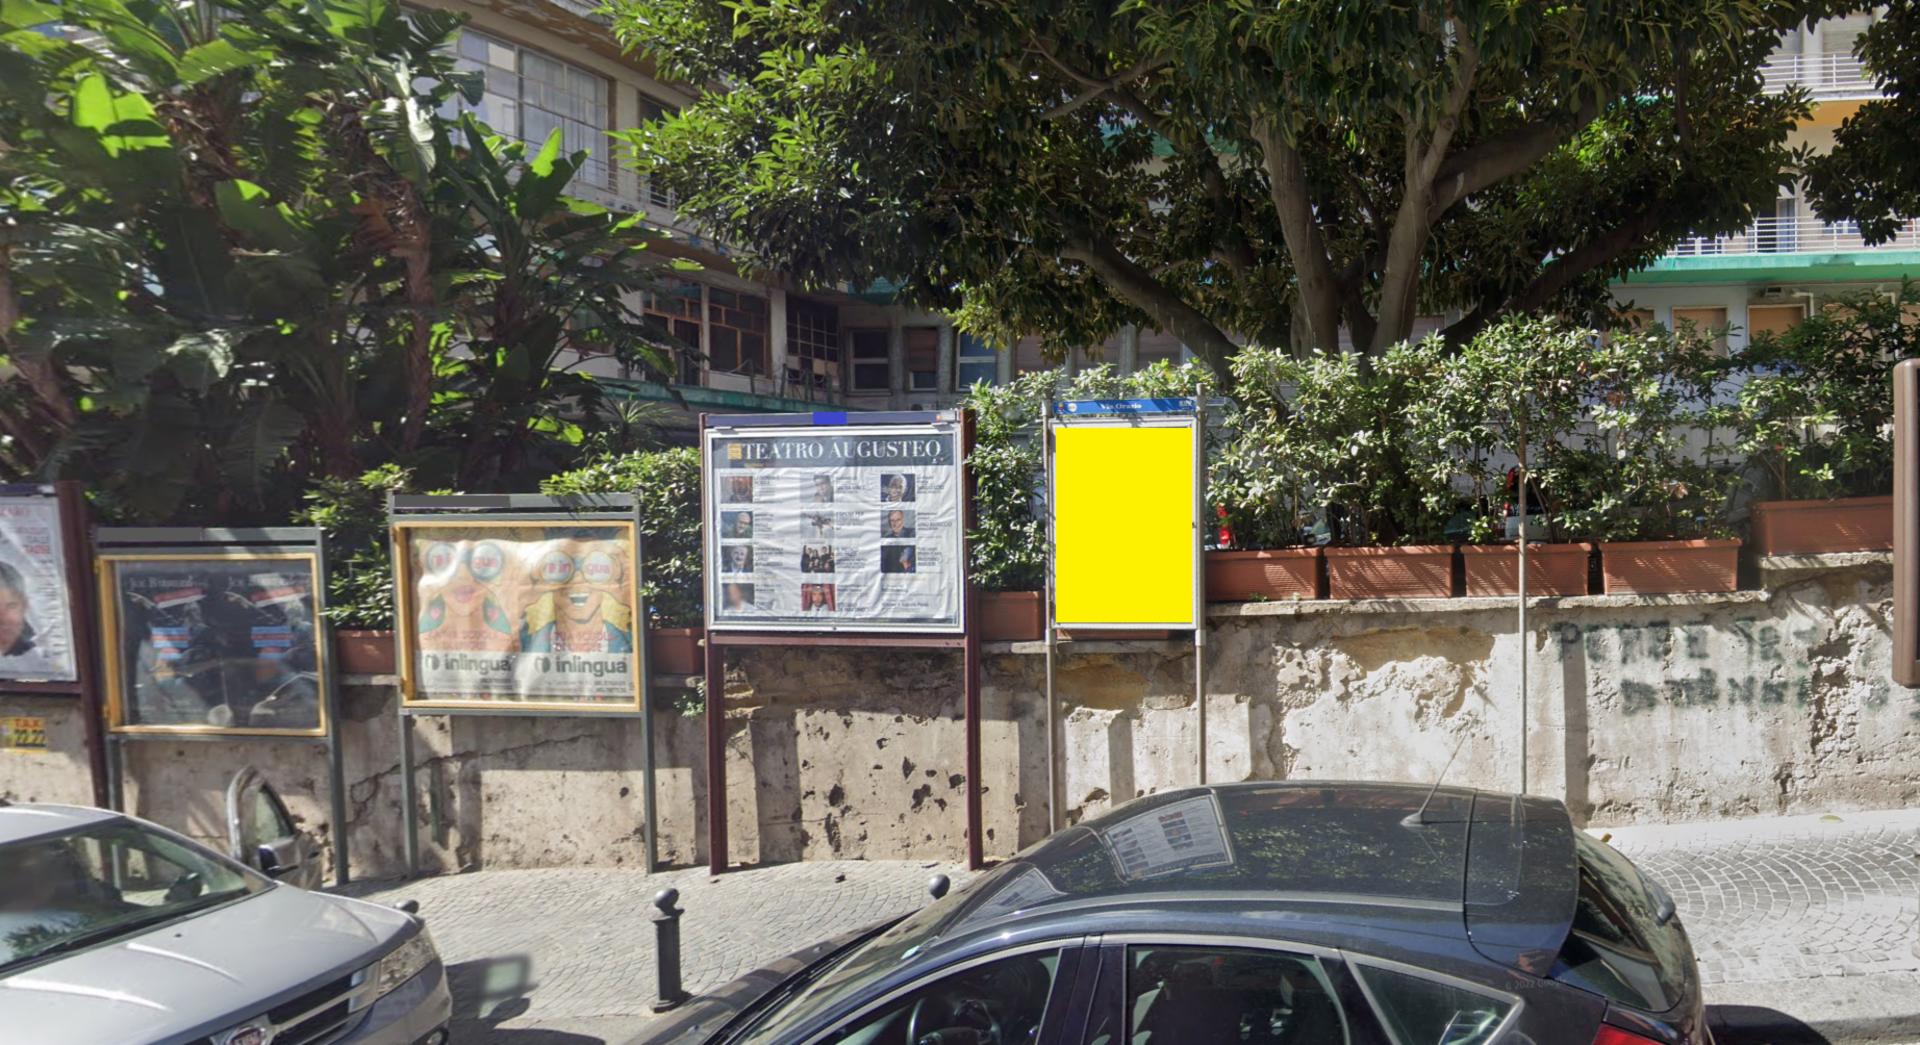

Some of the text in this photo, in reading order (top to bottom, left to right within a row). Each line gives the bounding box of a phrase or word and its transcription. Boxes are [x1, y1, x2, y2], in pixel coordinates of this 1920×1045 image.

[742, 439, 942, 460] TEATRO AUGUSTEO
[444, 654, 512, 674] inlingua
[555, 655, 628, 677] inlingua
